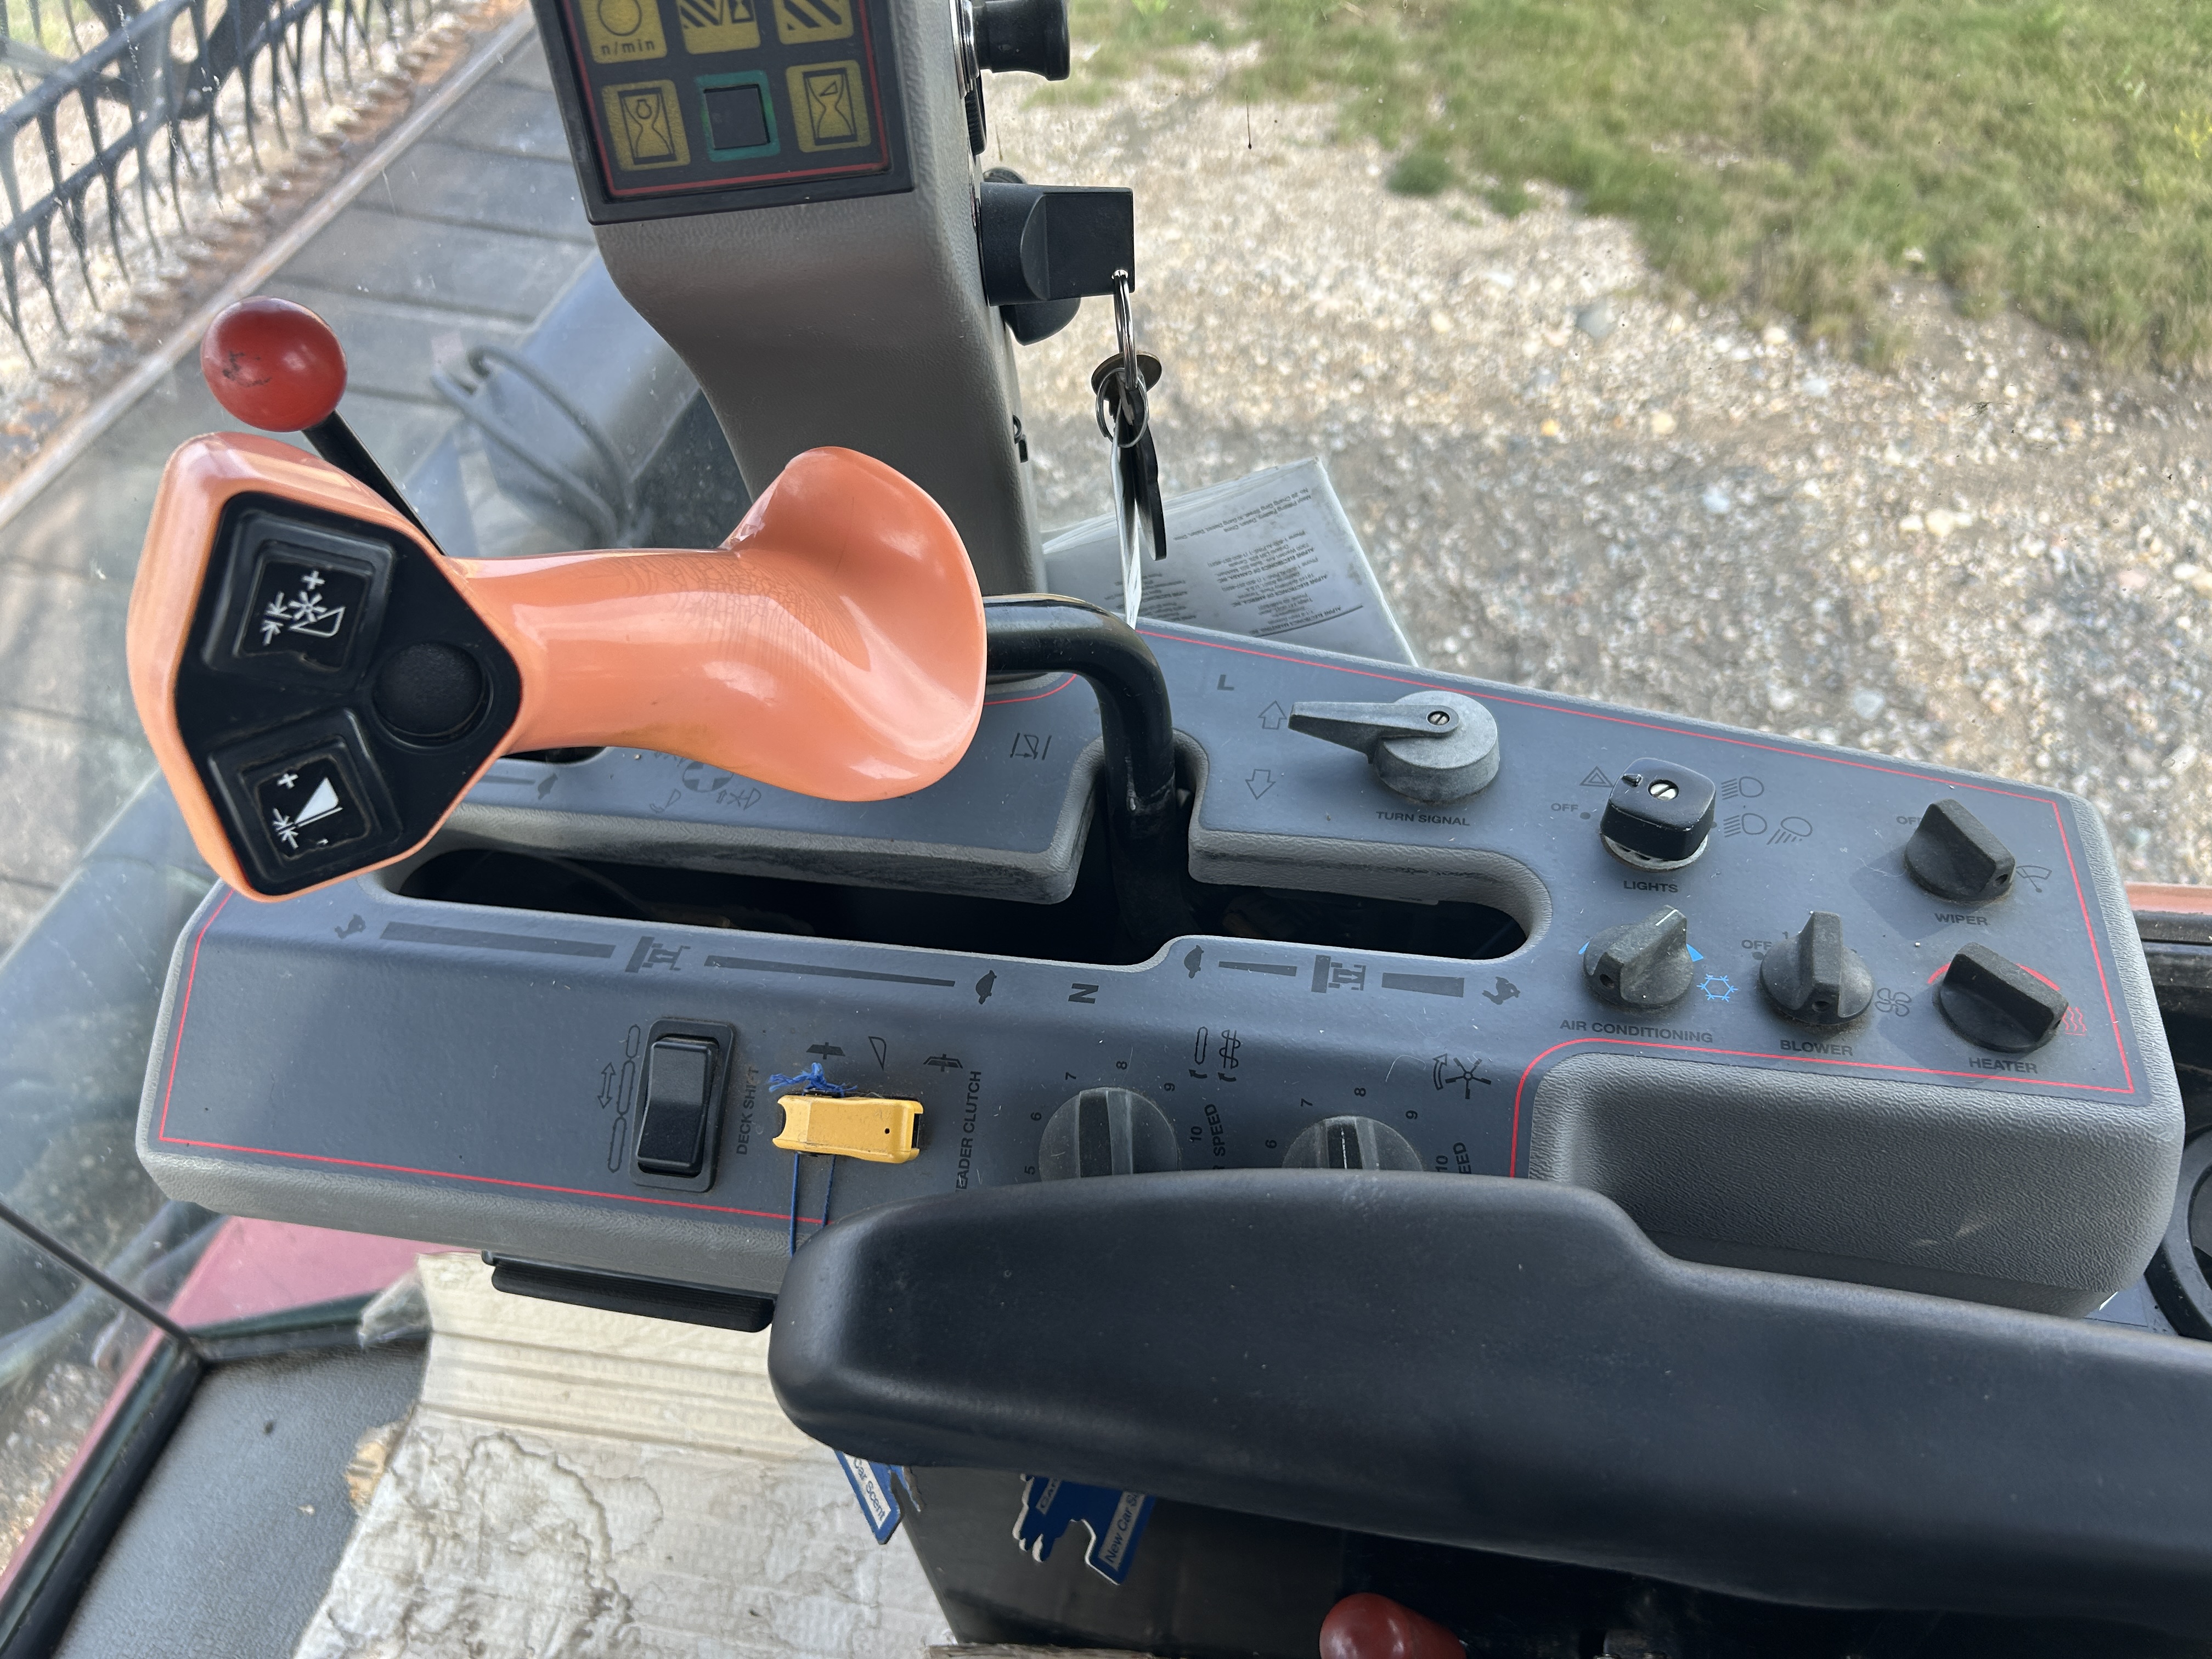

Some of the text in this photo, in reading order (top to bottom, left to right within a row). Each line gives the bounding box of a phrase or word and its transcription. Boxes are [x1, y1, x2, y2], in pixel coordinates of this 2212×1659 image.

[600, 39, 654, 55] n/min
[1217, 674, 1234, 691] L
[1551, 803, 1578, 812] OFF
[1376, 811, 1470, 826] TURN SIGNAL
[1623, 880, 1678, 894] LIGHTS
[1934, 913, 1988, 926] WIPER
[1741, 939, 1772, 950] OFF
[1560, 1019, 1713, 1043] AIR CONDITIONING
[1780, 1039, 1853, 1057] BLOWER
[1116, 1060, 1127, 1070] 8
[1968, 1057, 2038, 1074] HEATER
[1065, 1072, 1076, 1080] 7
[1164, 1082, 1175, 1092] 9
[1354, 1087, 1366, 1097] 8
[1300, 1098, 1313, 1107] 7
[1030, 1112, 1042, 1121] 6
[1406, 1110, 1418, 1119] 9
[736, 1113, 753, 1155] DECK
[955, 1071, 981, 1193] EADER CLUTCH
[1189, 1126, 1202, 1142] 10
[1204, 1104, 1226, 1156] SPEED
[1265, 1139, 1277, 1149] 6
[1435, 1155, 1448, 1172] 10
[1453, 1142, 1471, 1174] EED
[1024, 1165, 1035, 1175] 5
[853, 1459, 885, 1521] Car Scent
[1104, 1507, 1132, 1562] New Car
